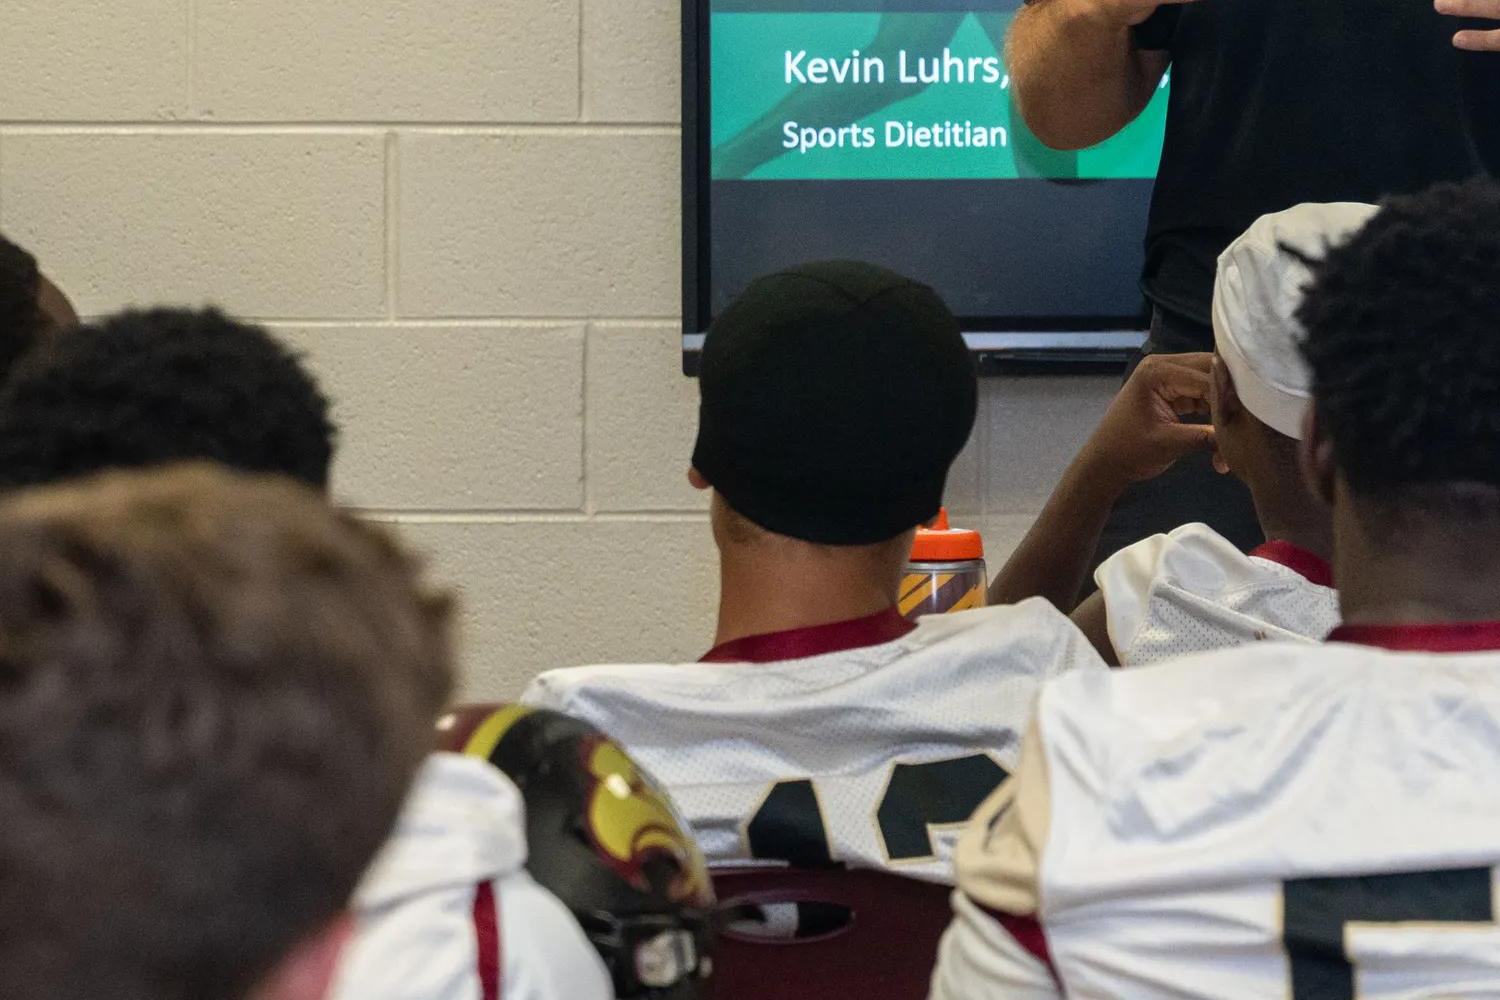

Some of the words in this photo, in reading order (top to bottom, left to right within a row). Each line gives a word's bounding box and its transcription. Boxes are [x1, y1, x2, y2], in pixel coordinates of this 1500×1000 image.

[784, 49, 884, 84] Kevin
[899, 48, 1009, 89] Luhrs,
[782, 121, 876, 154] Sports
[885, 121, 1007, 148] Dietitian
